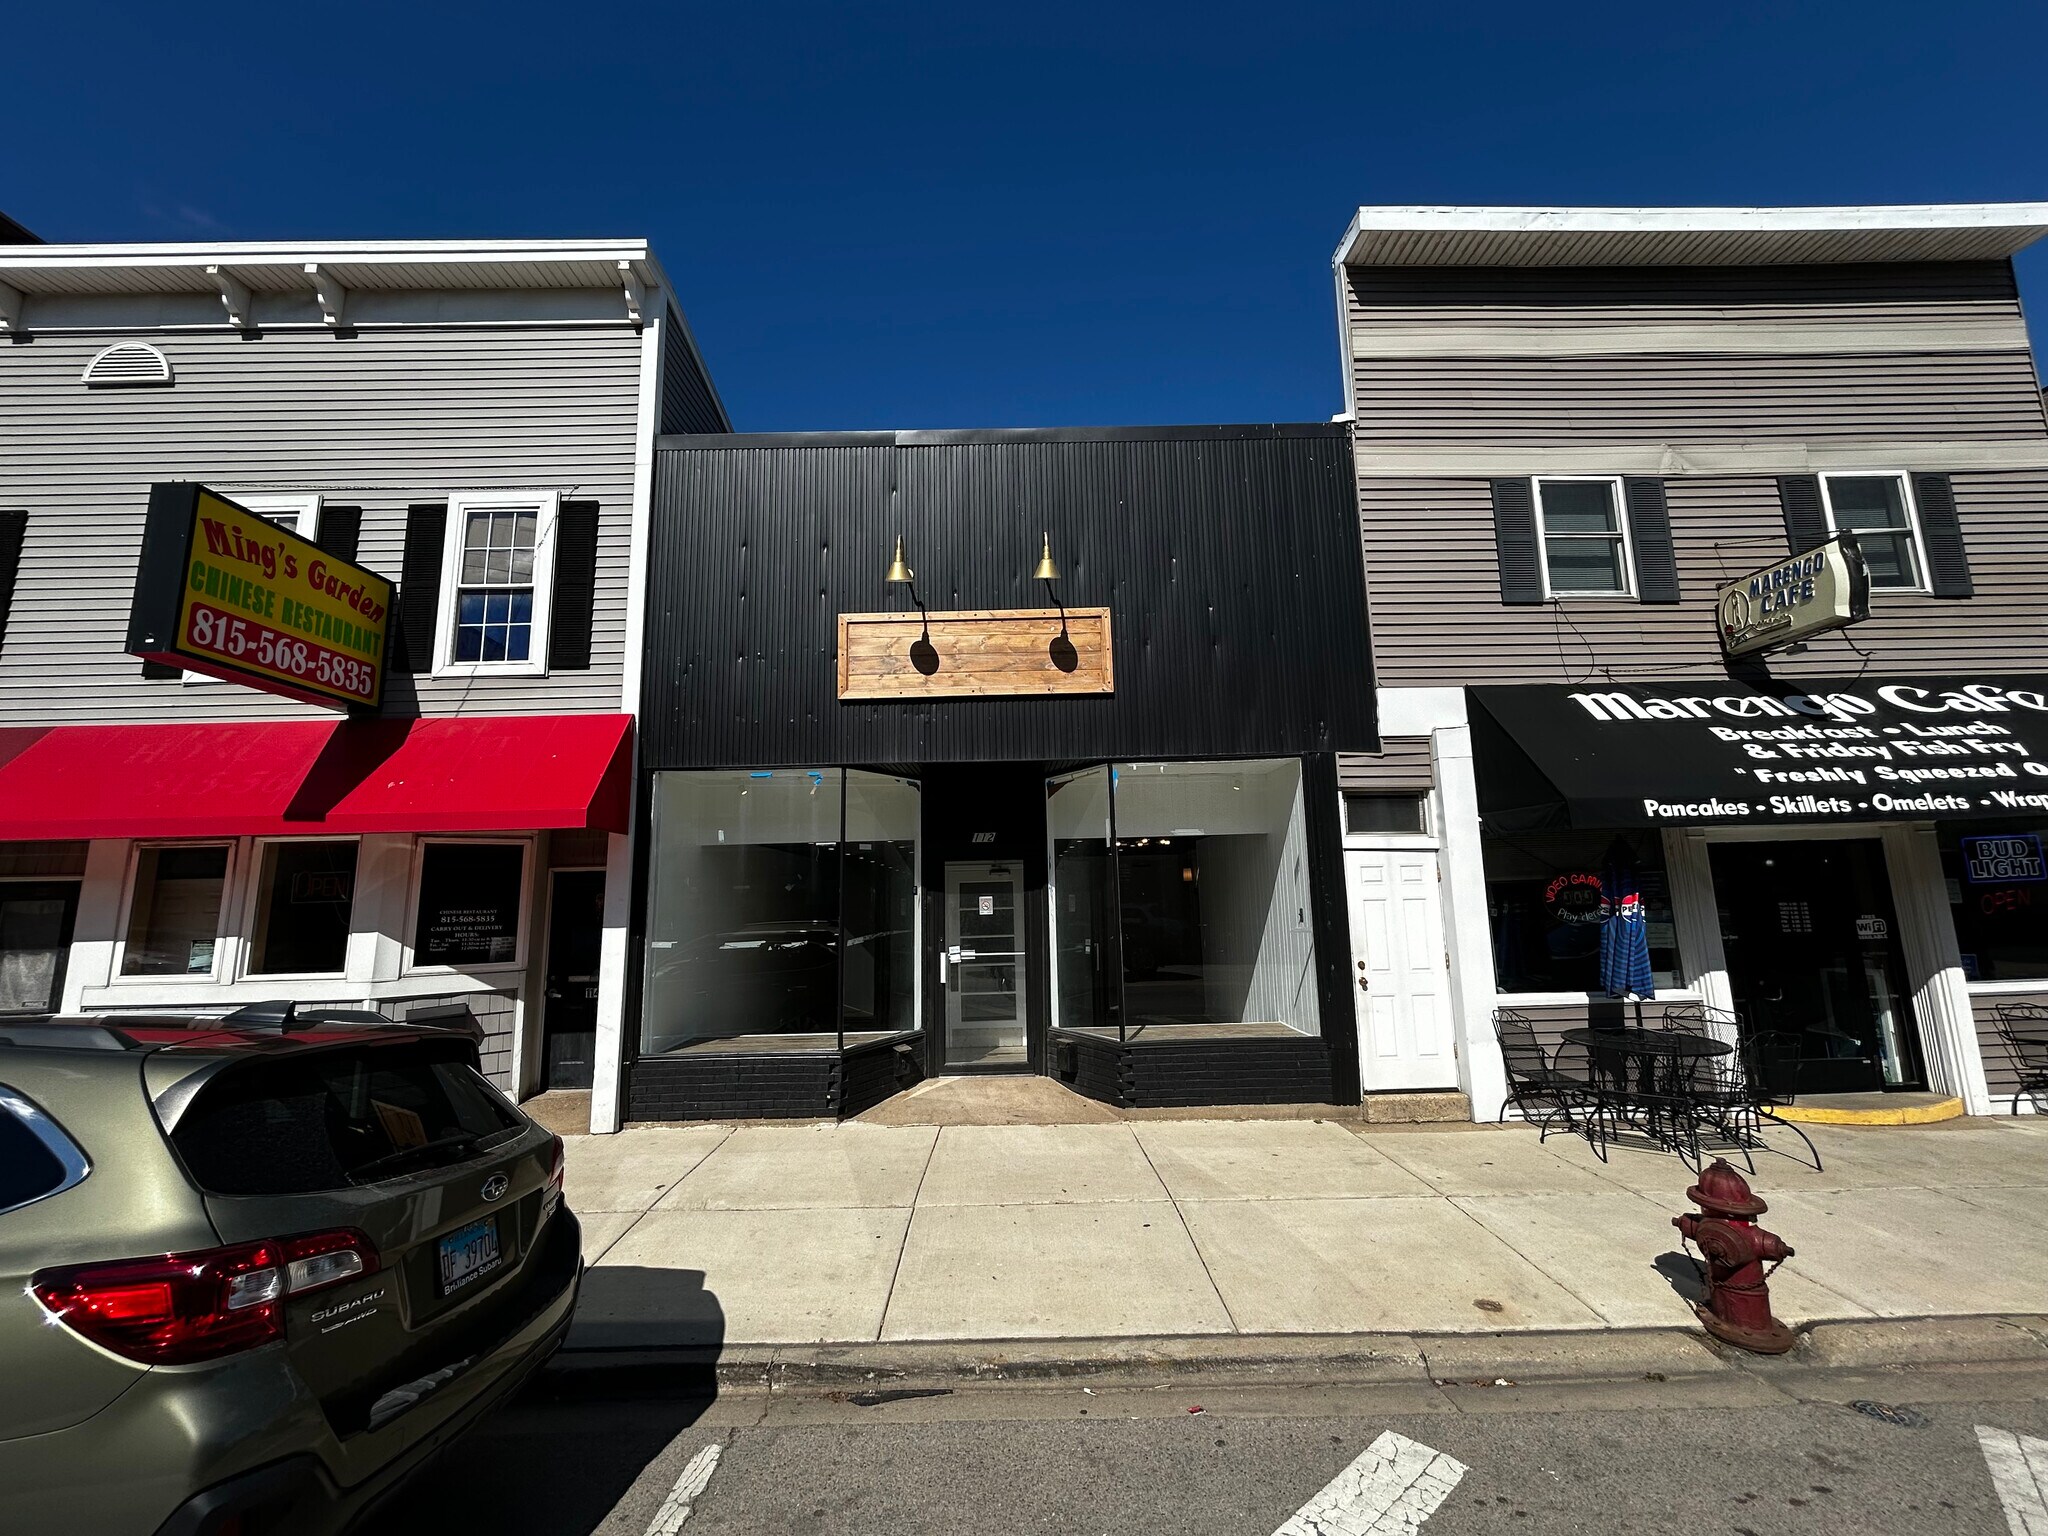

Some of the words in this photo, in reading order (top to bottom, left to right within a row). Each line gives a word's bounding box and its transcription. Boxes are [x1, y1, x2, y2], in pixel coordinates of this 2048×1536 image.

[200, 517, 298, 580] Ming's
[308, 560, 385, 624] Garden
[1749, 552, 1826, 599] MARENGO
[190, 560, 276, 620] CHINESE
[281, 597, 381, 657] RESTAURANT
[1761, 577, 1816, 614] CAFE
[192, 608, 372, 695] 815-568-5835
[1567, 692, 1876, 722] Marengo
[1708, 724, 1879, 741] Breakfast
[1900, 720, 2012, 737] Lunch
[1742, 743, 1782, 759] &
[1777, 742, 1893, 760] Friday
[1889, 740, 1971, 756] Fish
[1961, 738, 2030, 756] Fry
[1873, 762, 2018, 784] Squeezed
[1643, 798, 1750, 817] Pancakes
[1769, 795, 1852, 815] Skillets
[1872, 793, 1970, 812] Omelets
[973, 833, 996, 842] 112
[1976, 840, 2028, 860] BUD
[1970, 857, 2041, 879] LIGHT
[295, 870, 346, 899] OPEN
[1546, 876, 1568, 903] VIDEO
[440, 915, 495, 923] 815-568-5835
[1557, 907, 1579, 923] Play
[444, 1271, 479, 1296] Brilliance
[478, 1257, 502, 1276] Subaru
[310, 1288, 386, 1323] SUBARU
